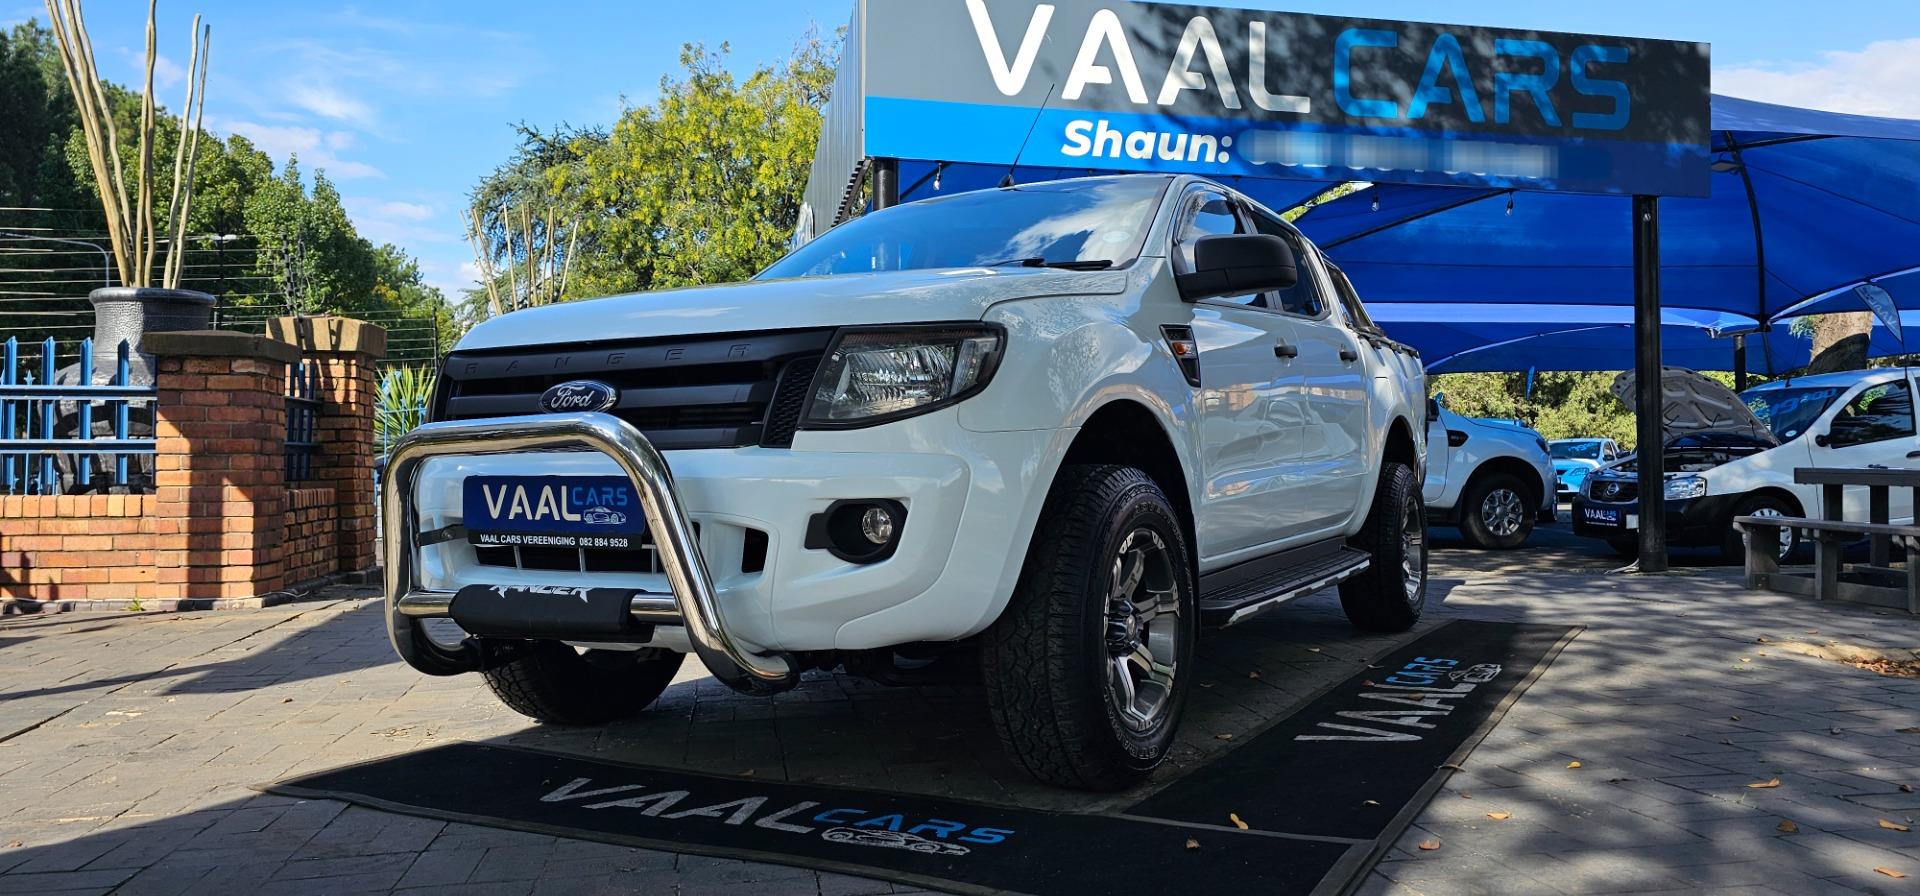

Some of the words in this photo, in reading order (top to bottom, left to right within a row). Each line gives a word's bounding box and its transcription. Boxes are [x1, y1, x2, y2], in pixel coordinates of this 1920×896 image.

[965, 0, 1311, 113] VAAL
[1333, 27, 1631, 131] CARS
[1060, 119, 1233, 164] Shaun:
[551, 385, 592, 408] Ford
[482, 484, 582, 522] VAAL
[572, 487, 628, 507] CARS
[480, 534, 500, 543] VAAL
[500, 534, 521, 544] CARS
[522, 535, 576, 546] VEREENIGING
[609, 538, 628, 548] 9528
[1293, 682, 1478, 742] VAAL
[540, 777, 821, 835] VAAL
[813, 808, 1016, 844] CARS
